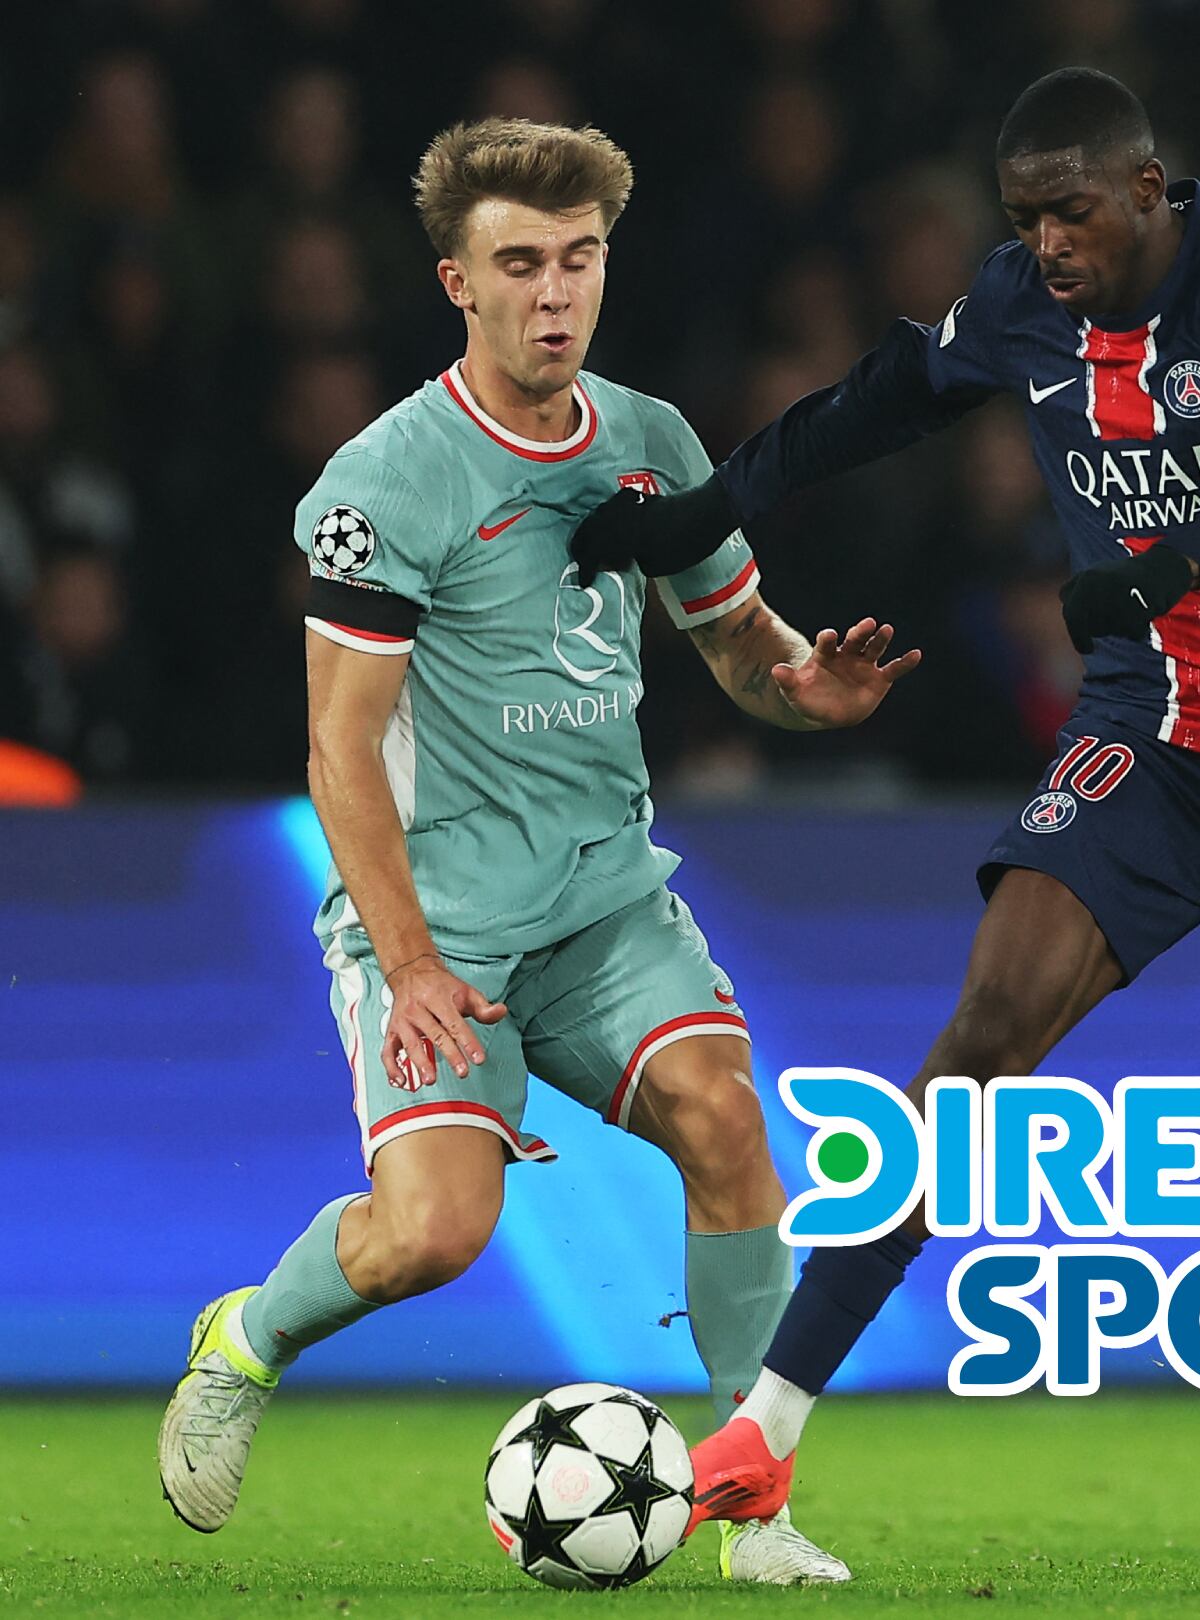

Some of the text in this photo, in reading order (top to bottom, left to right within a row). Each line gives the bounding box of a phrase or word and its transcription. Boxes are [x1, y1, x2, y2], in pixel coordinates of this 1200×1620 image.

[503, 690, 620, 734] RIYADH
[1048, 735, 1135, 802] 10
[1040, 794, 1073, 808] PARIS
